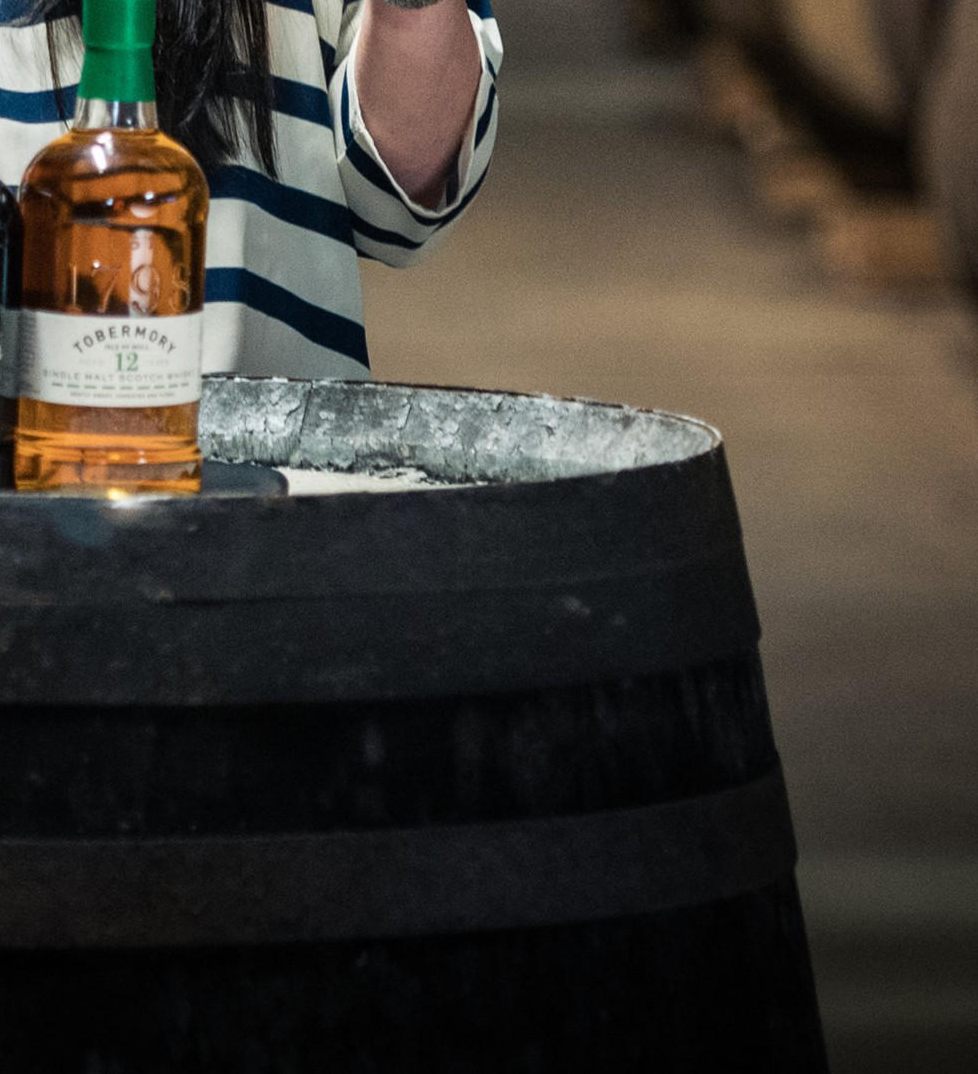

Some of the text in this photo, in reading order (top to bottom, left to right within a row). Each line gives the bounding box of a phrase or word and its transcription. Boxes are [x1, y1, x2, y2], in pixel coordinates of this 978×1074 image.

[72, 324, 177, 354] TOBERMORY
[116, 352, 139, 371] 12
[84, 373, 112, 382] MALT
[119, 373, 164, 383] SCOTCH
